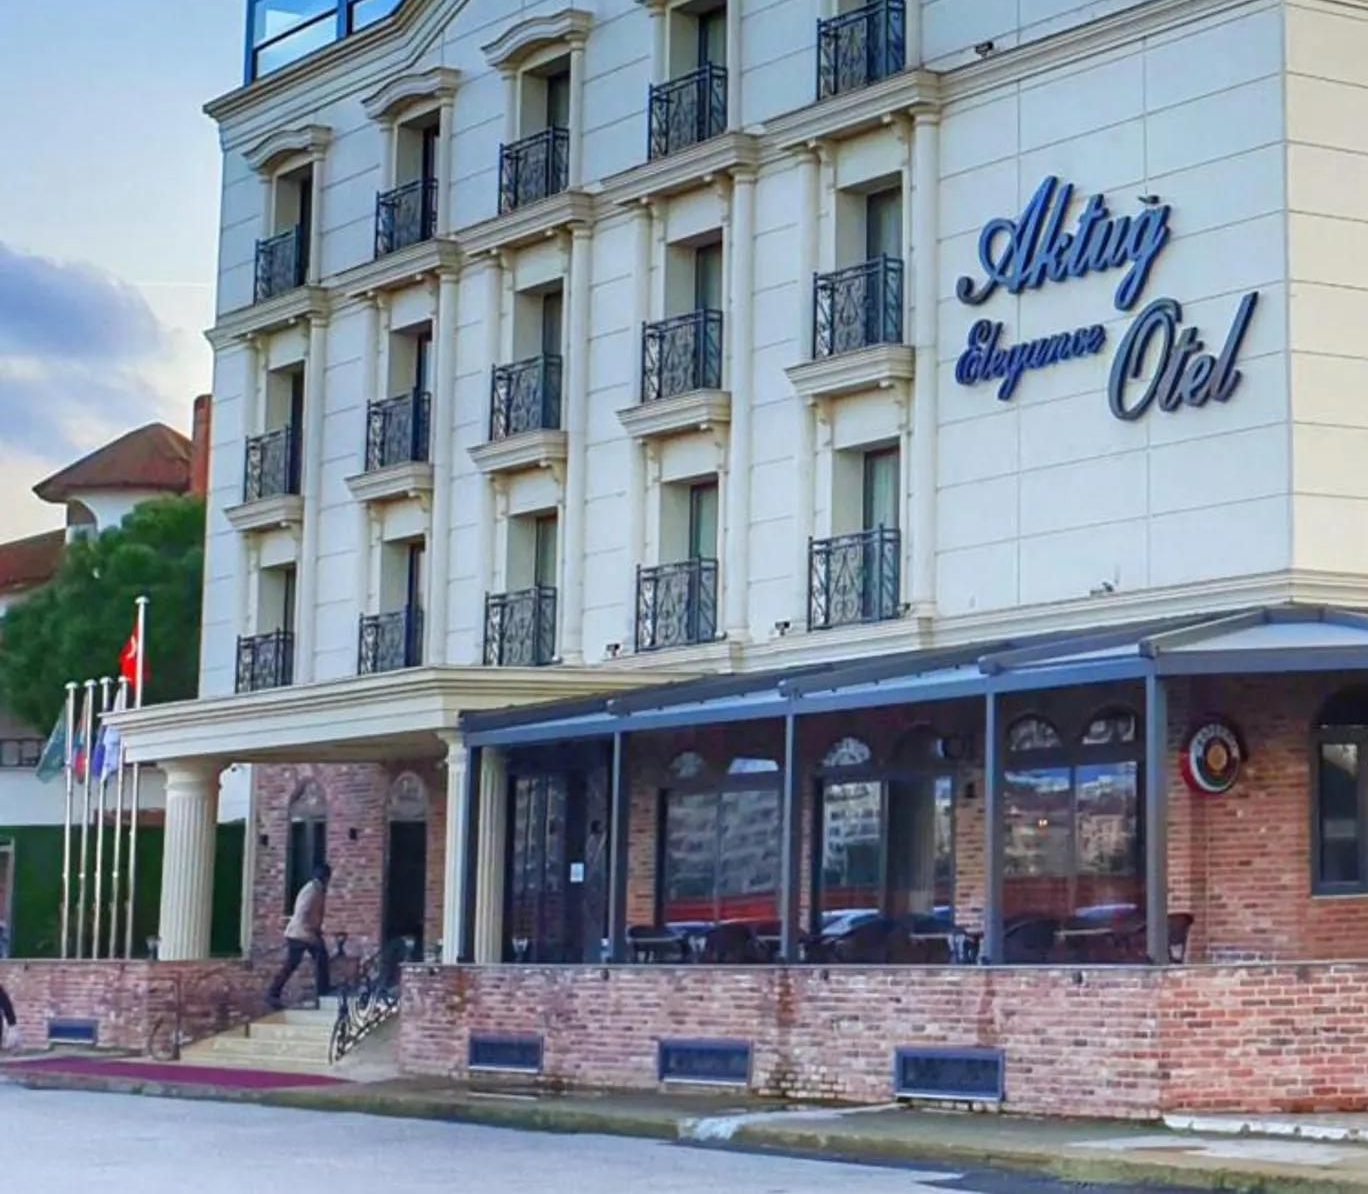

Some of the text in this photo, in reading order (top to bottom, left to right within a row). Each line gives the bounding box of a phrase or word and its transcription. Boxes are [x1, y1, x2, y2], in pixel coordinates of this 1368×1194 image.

[956, 175, 1172, 311] Aktuğ
[955, 291, 1259, 422] Elegance Otel
